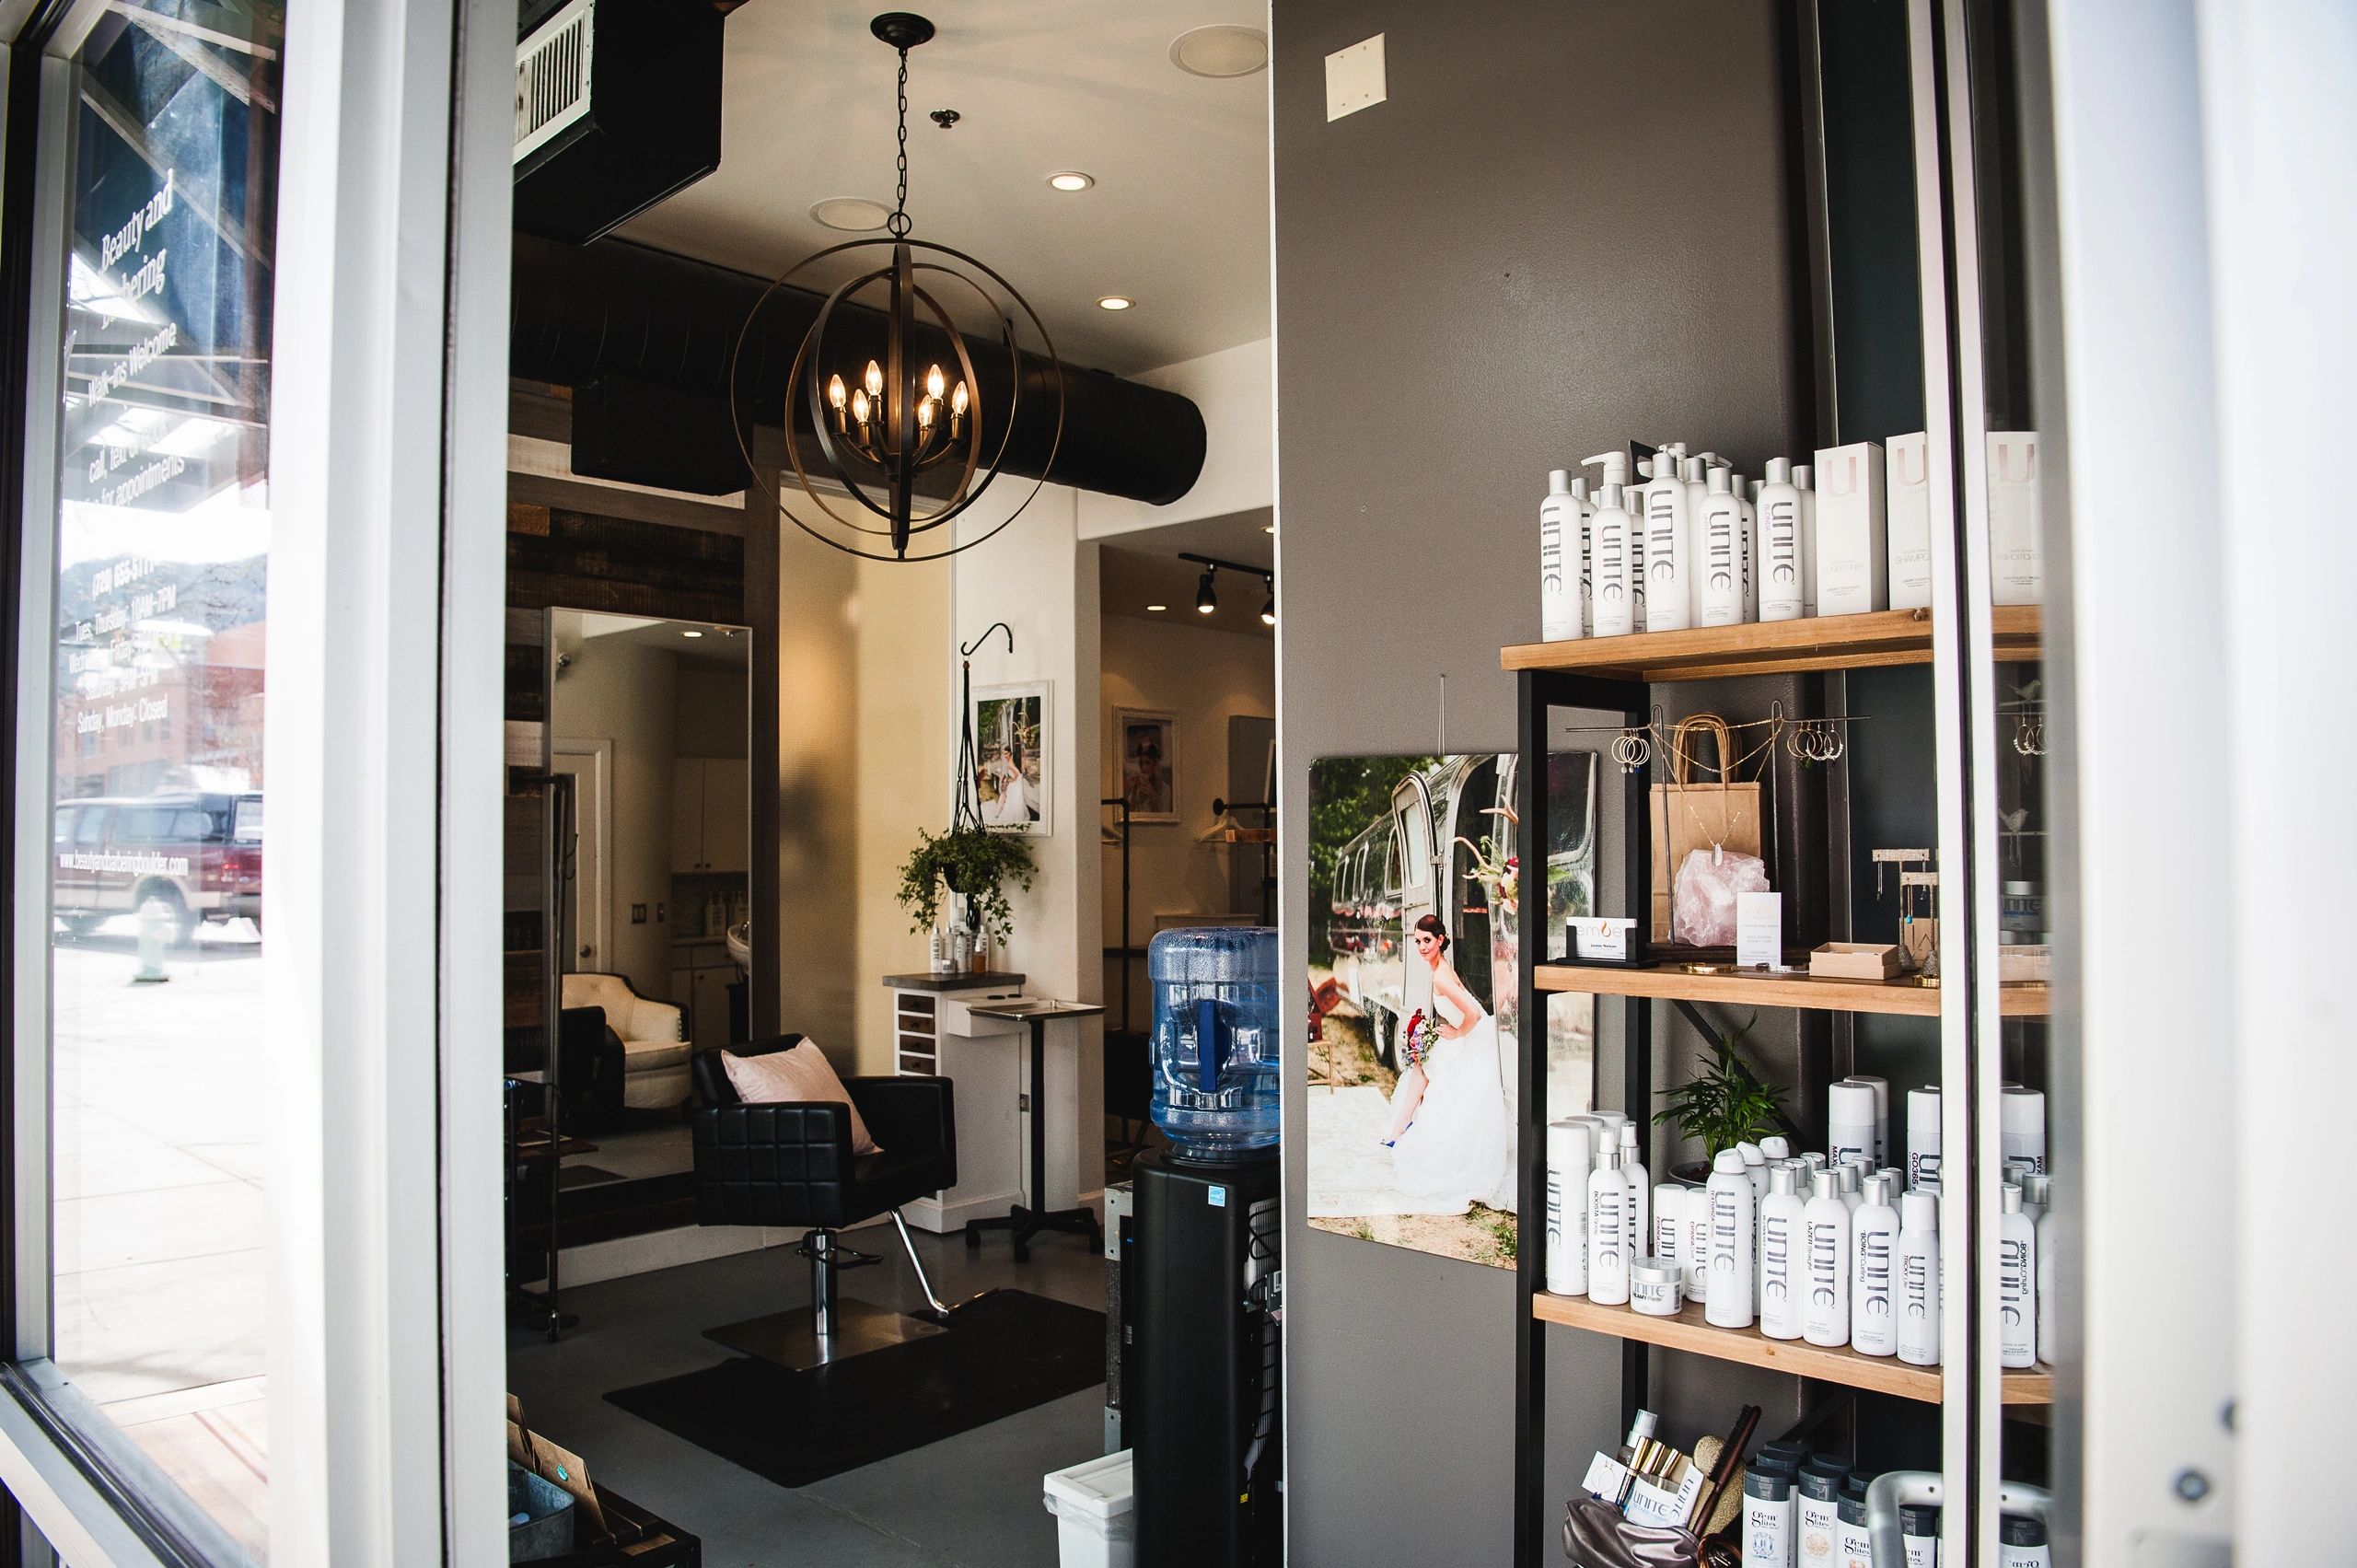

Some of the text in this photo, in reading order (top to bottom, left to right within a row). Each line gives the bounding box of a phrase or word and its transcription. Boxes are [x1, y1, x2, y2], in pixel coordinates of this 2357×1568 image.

[100, 168, 174, 273] Beauty and
[88, 321, 178, 407] Walk-ins Welcome
[116, 456, 185, 506] appointments
[1542, 506, 1562, 596] UNITE
[1601, 525, 1623, 602] UNITE
[1649, 489, 1674, 583] UNITE
[1709, 511, 1732, 592] UNITE
[1771, 501, 1795, 585] UNITE
[1894, 552, 1931, 565] SHAMPO
[138, 692, 168, 723] Closed
[1598, 1191, 1620, 1268] UNITE
[1661, 1218, 1675, 1260] UNIT
[1713, 1191, 1736, 1272] UNITE
[1766, 1216, 1787, 1300] UNITE
[1812, 1223, 1836, 1307] UNITE
[1865, 1231, 1889, 1316] UNITE
[1908, 1255, 1925, 1318] UNITE
[1633, 1490, 1671, 1517] UNITE
